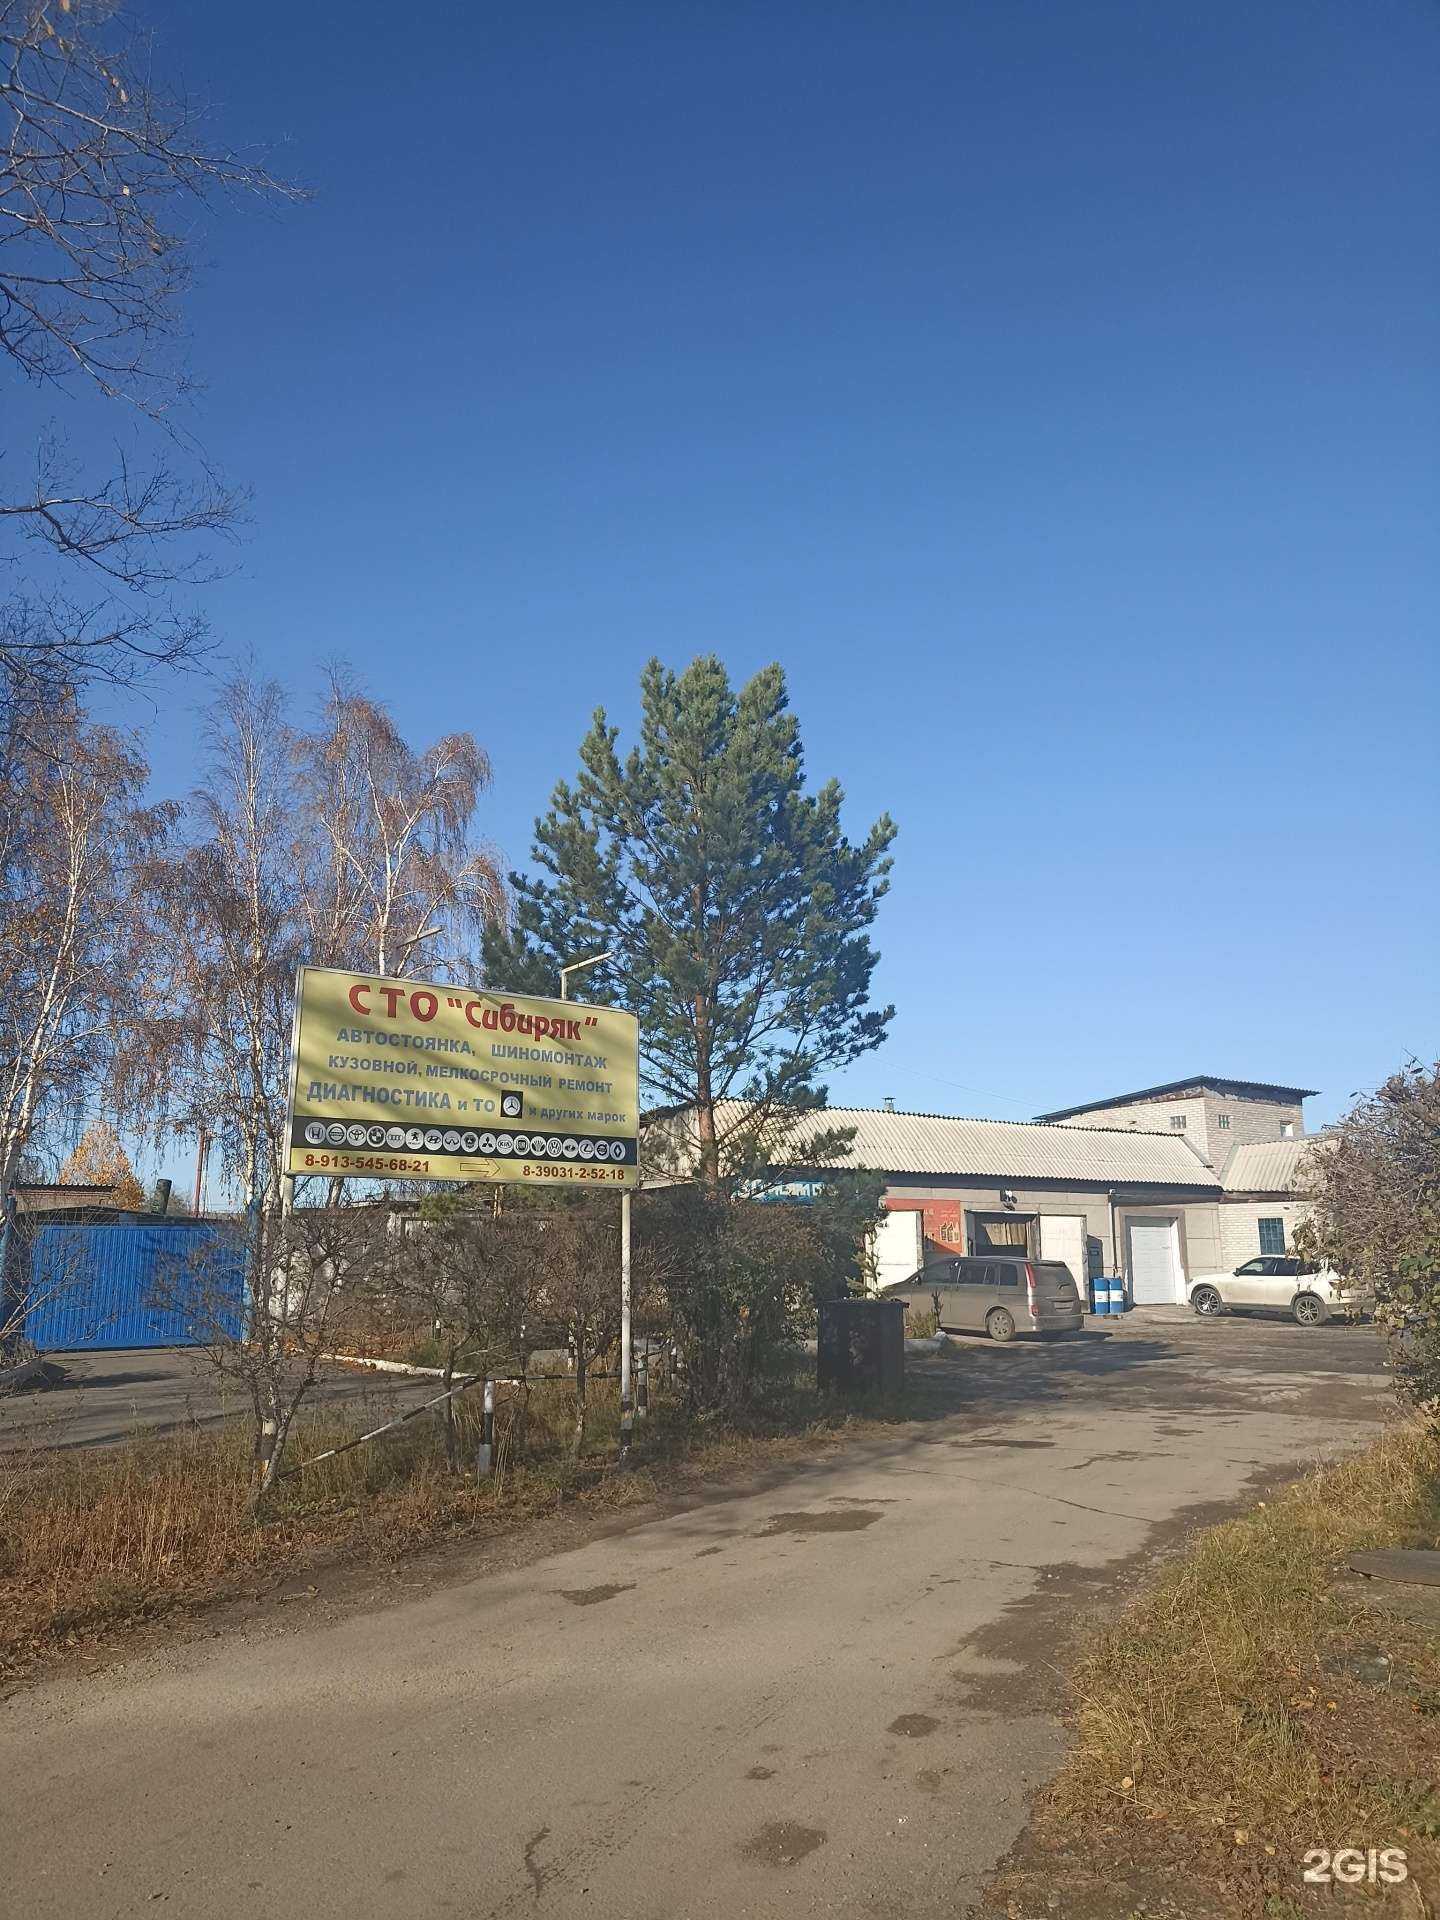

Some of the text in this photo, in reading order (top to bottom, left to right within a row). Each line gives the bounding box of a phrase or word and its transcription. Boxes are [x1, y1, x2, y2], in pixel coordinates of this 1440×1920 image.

[349, 984, 438, 1022] СТО
[336, 1027, 608, 1069] АВТОСТОЯНКА, ШИНОМОНТАЖ
[328, 1055, 613, 1093] КУЗОВНОЙ, МЕЛКОСРОЧНЫЙ РЕМОНТ
[306, 1081, 451, 1110] ДИАГНОСТИКА
[457, 1100, 468, 1111] и
[473, 1098, 496, 1113] ТО
[540, 1107, 583, 1120] других
[587, 1112, 626, 1124] марок
[304, 1153, 430, 1173] 8-913-545-68-21
[522, 1164, 625, 1181] 8-39031-2-52-18
